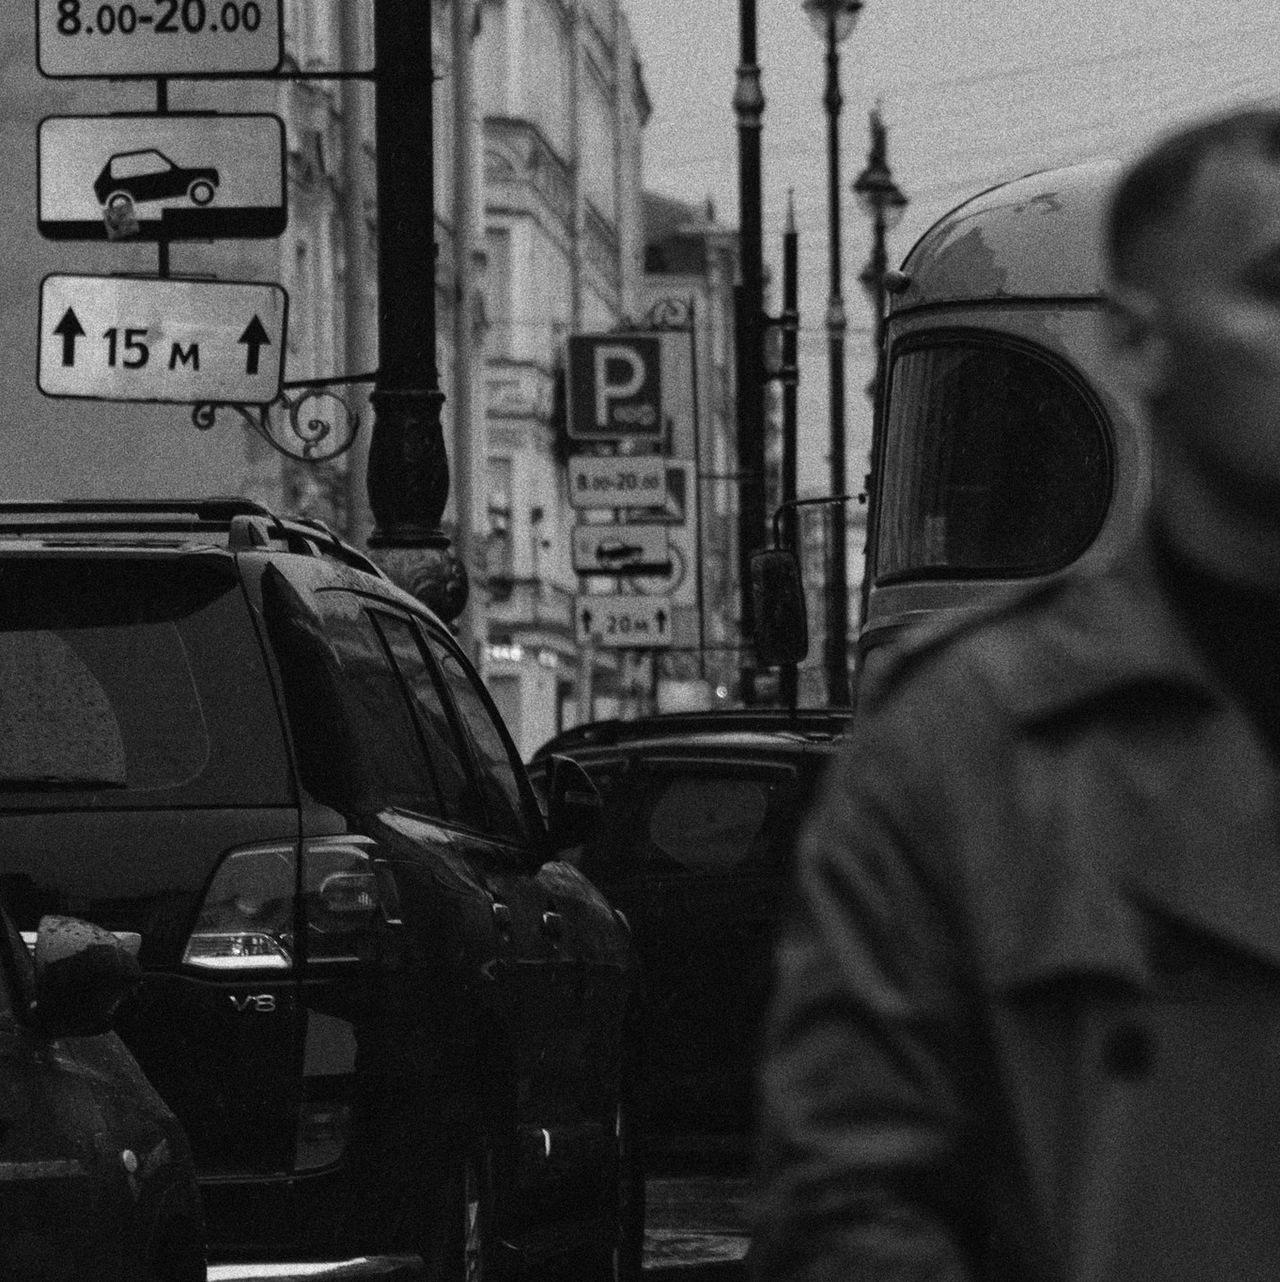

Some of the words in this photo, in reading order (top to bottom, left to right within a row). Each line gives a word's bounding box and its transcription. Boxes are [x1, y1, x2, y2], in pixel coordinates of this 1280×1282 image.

[102, 328, 149, 370] 15
[594, 345, 645, 426] P
[606, 614, 631, 634] 20
[228, 994, 276, 1013] V8
